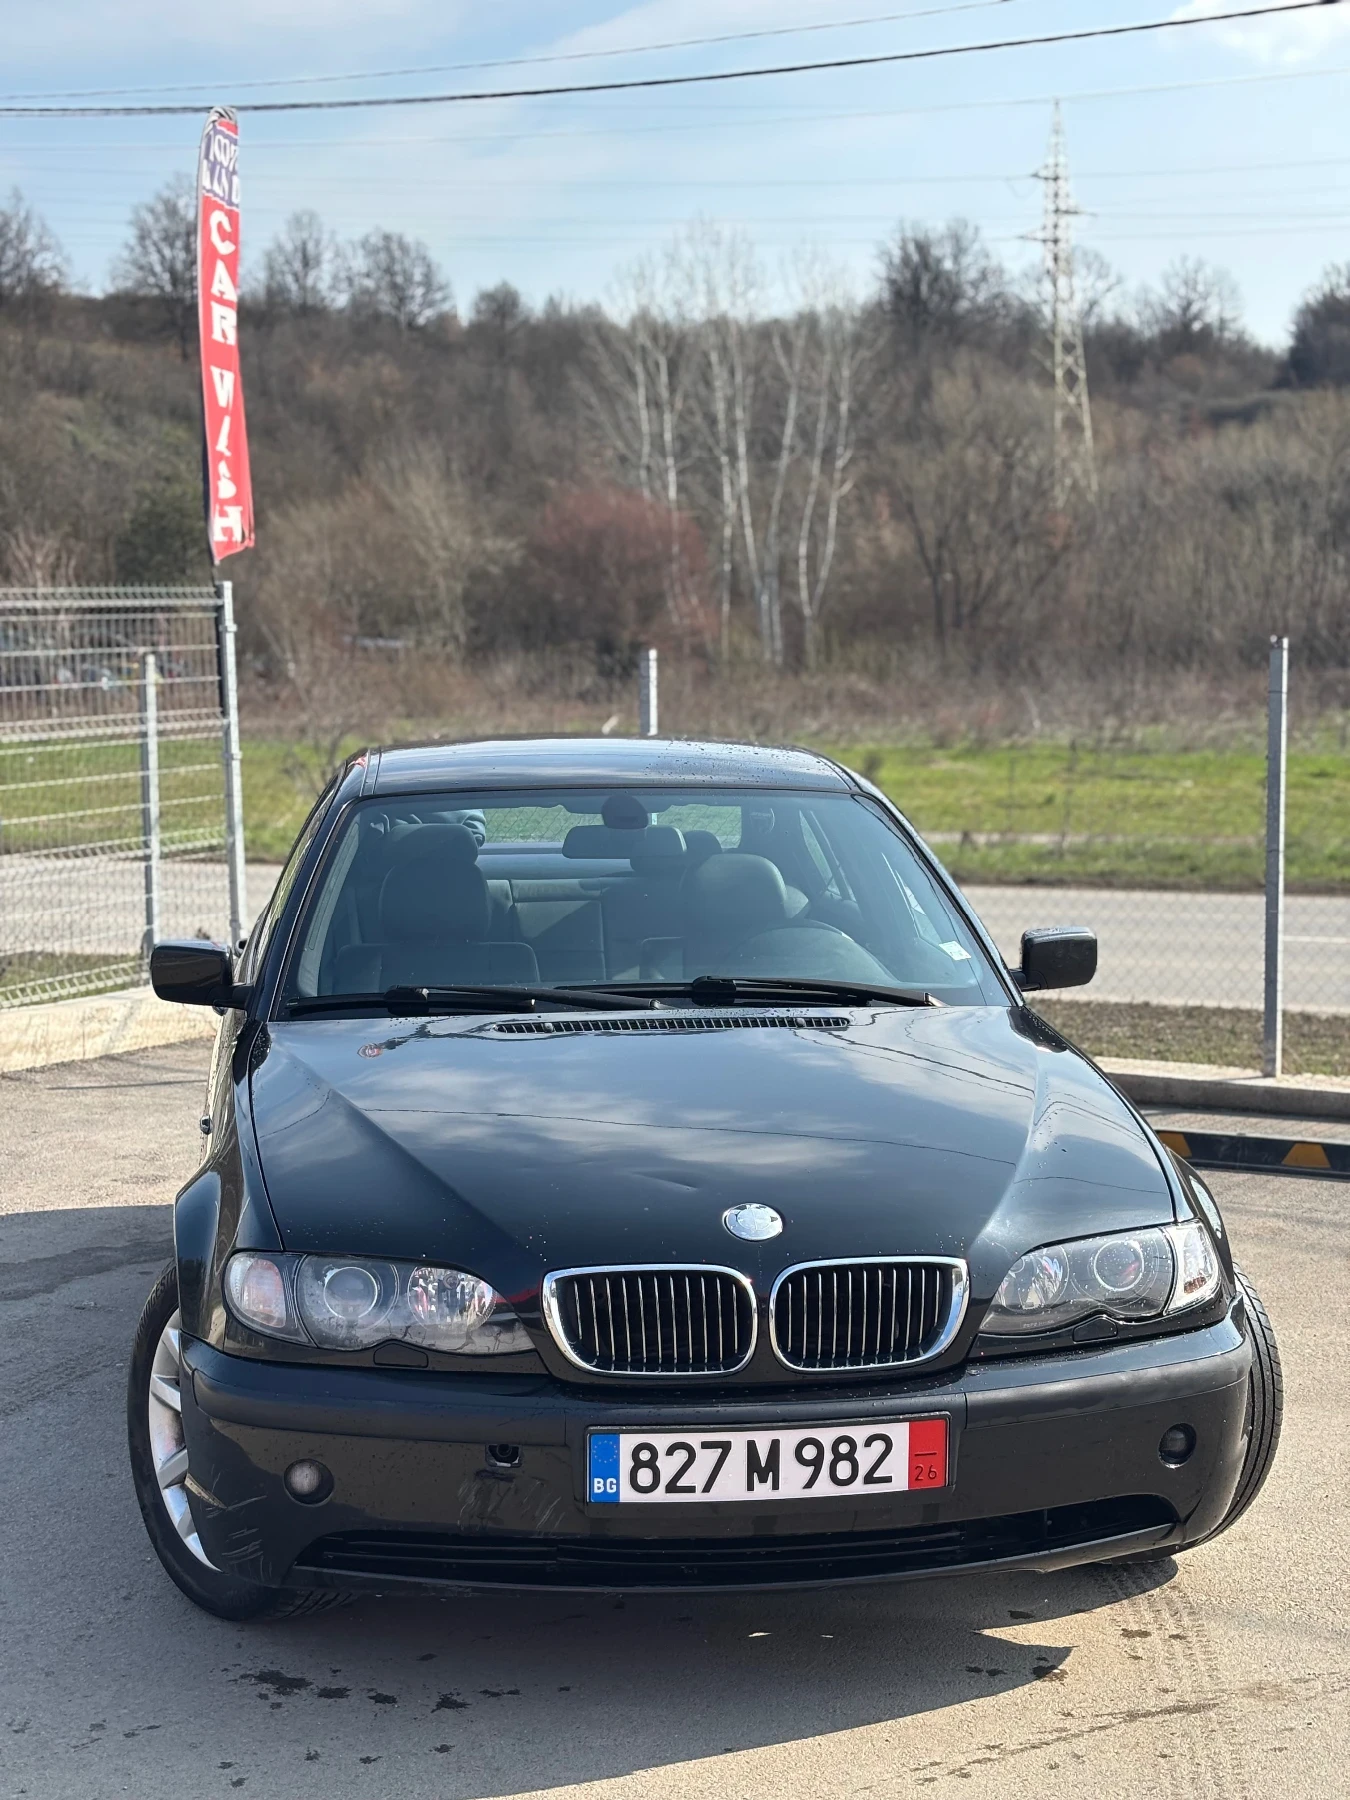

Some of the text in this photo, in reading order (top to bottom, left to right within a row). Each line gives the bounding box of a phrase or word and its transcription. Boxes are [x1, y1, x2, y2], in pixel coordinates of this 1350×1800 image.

[209, 210, 237, 346] CAR
[629, 1433, 893, 1493] 827 M 982
[914, 1464, 937, 1481] 26
[593, 1478, 617, 1493] BG
